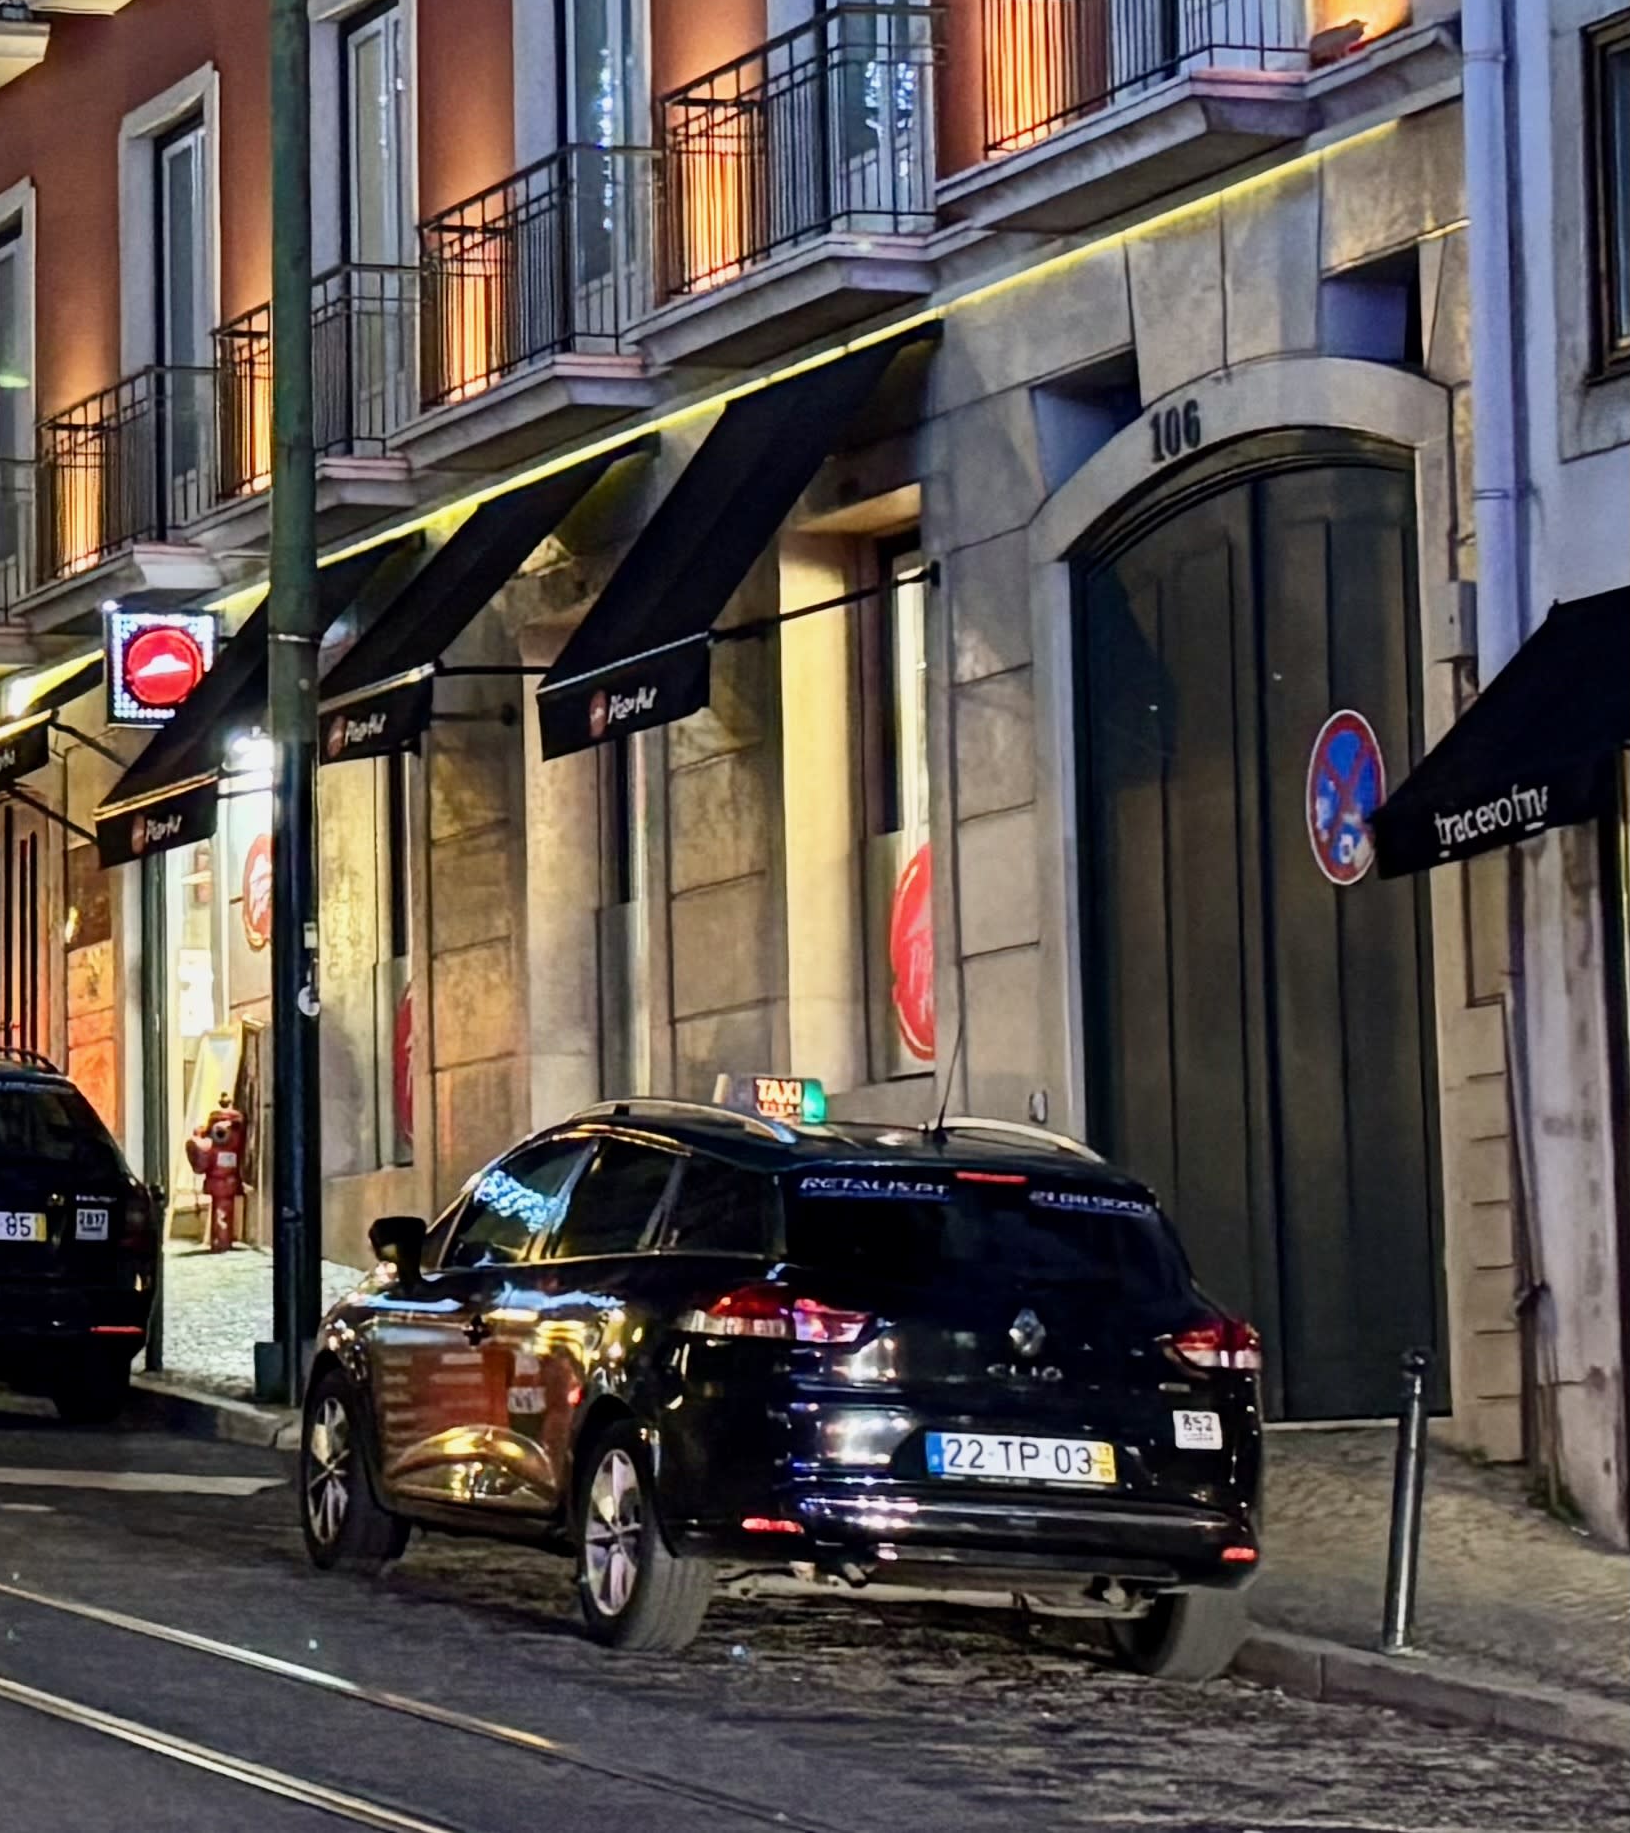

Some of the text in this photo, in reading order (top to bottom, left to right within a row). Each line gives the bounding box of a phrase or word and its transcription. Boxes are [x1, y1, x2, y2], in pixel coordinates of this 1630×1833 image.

[1149, 398, 1201, 464] 106
[755, 1078, 802, 1103] TAXI
[6, 1216, 32, 1238] 85
[946, 1438, 985, 1469] 22
[997, 1441, 1040, 1472] TP
[1054, 1445, 1092, 1475] 03
